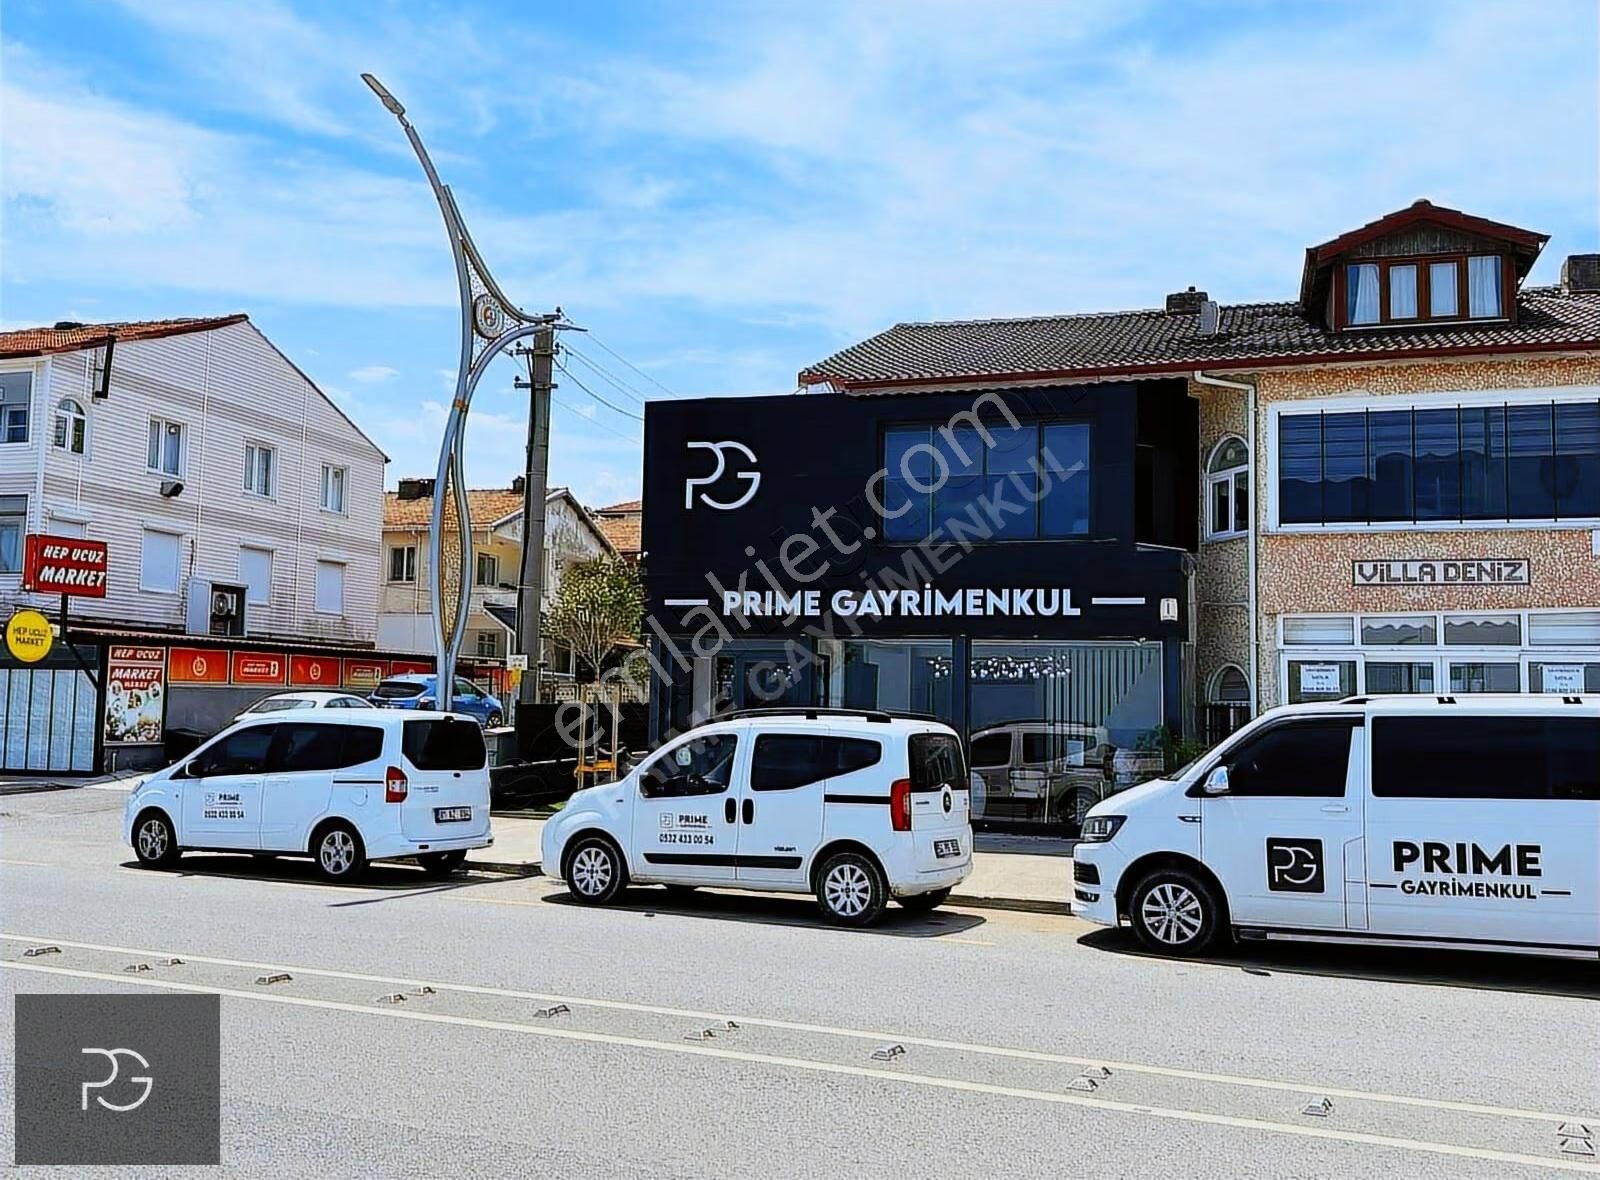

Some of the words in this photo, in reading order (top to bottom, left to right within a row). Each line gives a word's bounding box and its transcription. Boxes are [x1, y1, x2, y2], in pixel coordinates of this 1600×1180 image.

[43, 544, 69, 560] HEP
[71, 548, 105, 564] UCUZ
[39, 565, 106, 588] MARKET
[722, 589, 821, 616] PRIME
[831, 583, 1081, 616] GAYRİMENKUL
[15, 636, 45, 647] MARKET
[111, 667, 161, 680] MARKET
[678, 814, 708, 824] PRIME
[659, 833, 677, 844] 0532
[678, 834, 692, 844] 433
[704, 835, 714, 845] 54
[1393, 841, 1542, 876] PRIME
[1401, 878, 1537, 899] GAYRİMENKUL
